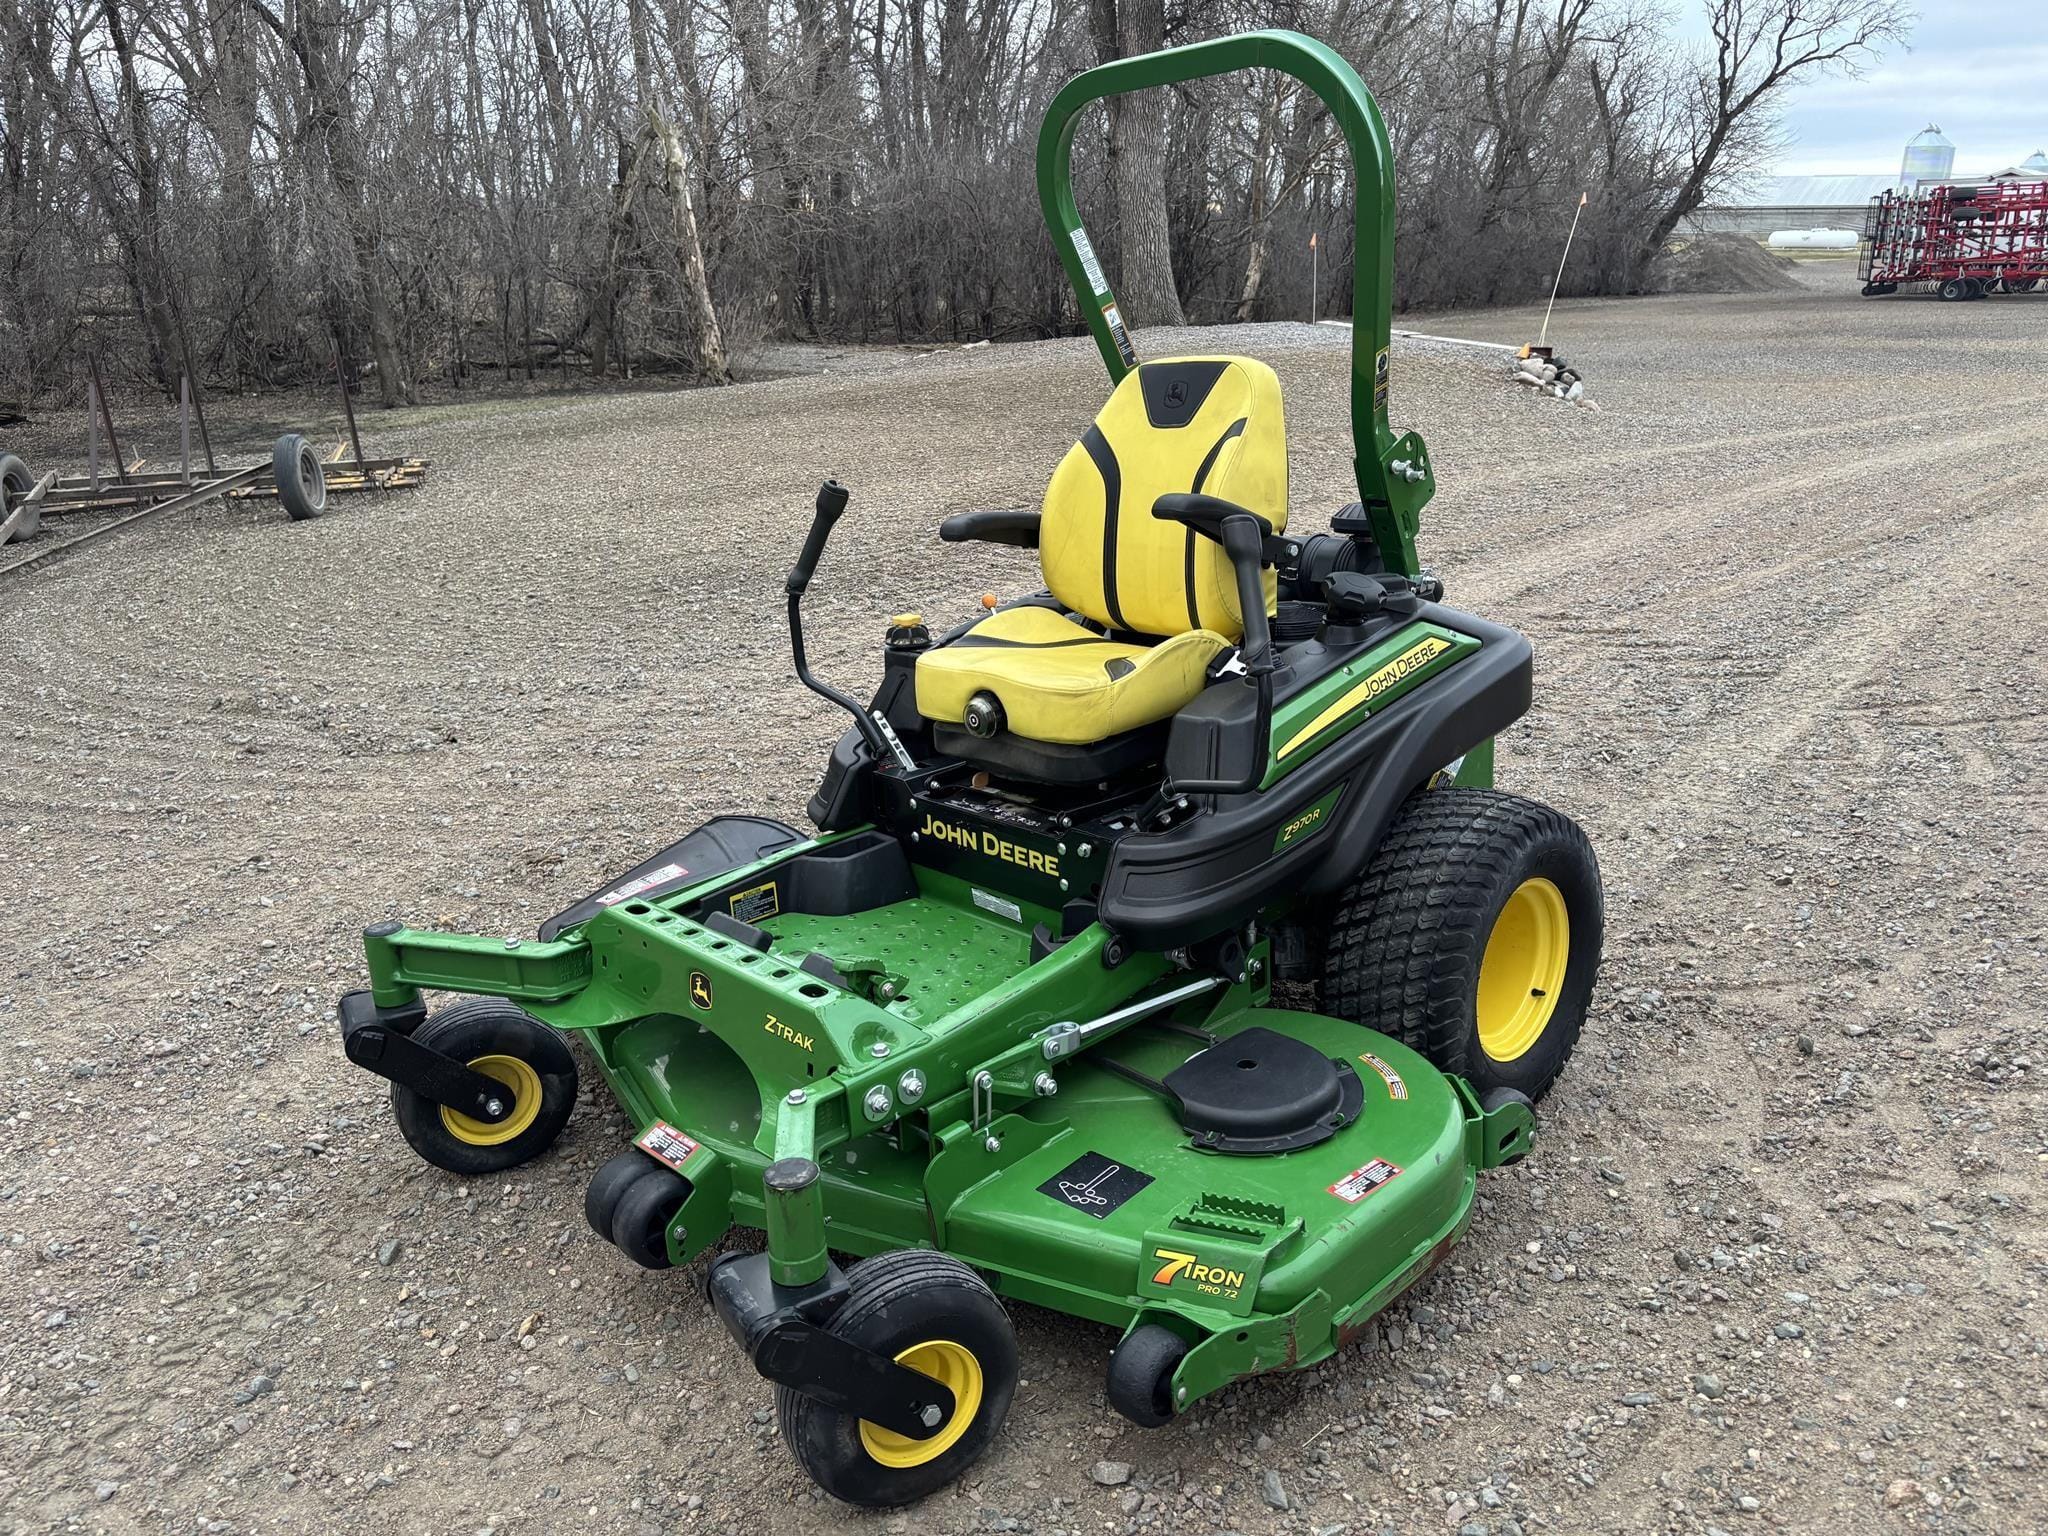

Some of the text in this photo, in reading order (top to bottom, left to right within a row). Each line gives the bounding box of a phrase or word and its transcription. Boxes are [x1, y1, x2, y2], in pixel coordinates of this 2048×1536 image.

[1364, 643, 1437, 698] JOHN DEERE
[1282, 808, 1320, 842] Z970R
[921, 814, 1060, 877] JOHN DEERE
[764, 1014, 815, 1052] ZTRAK
[1197, 1284, 1239, 1299] PRO 72
